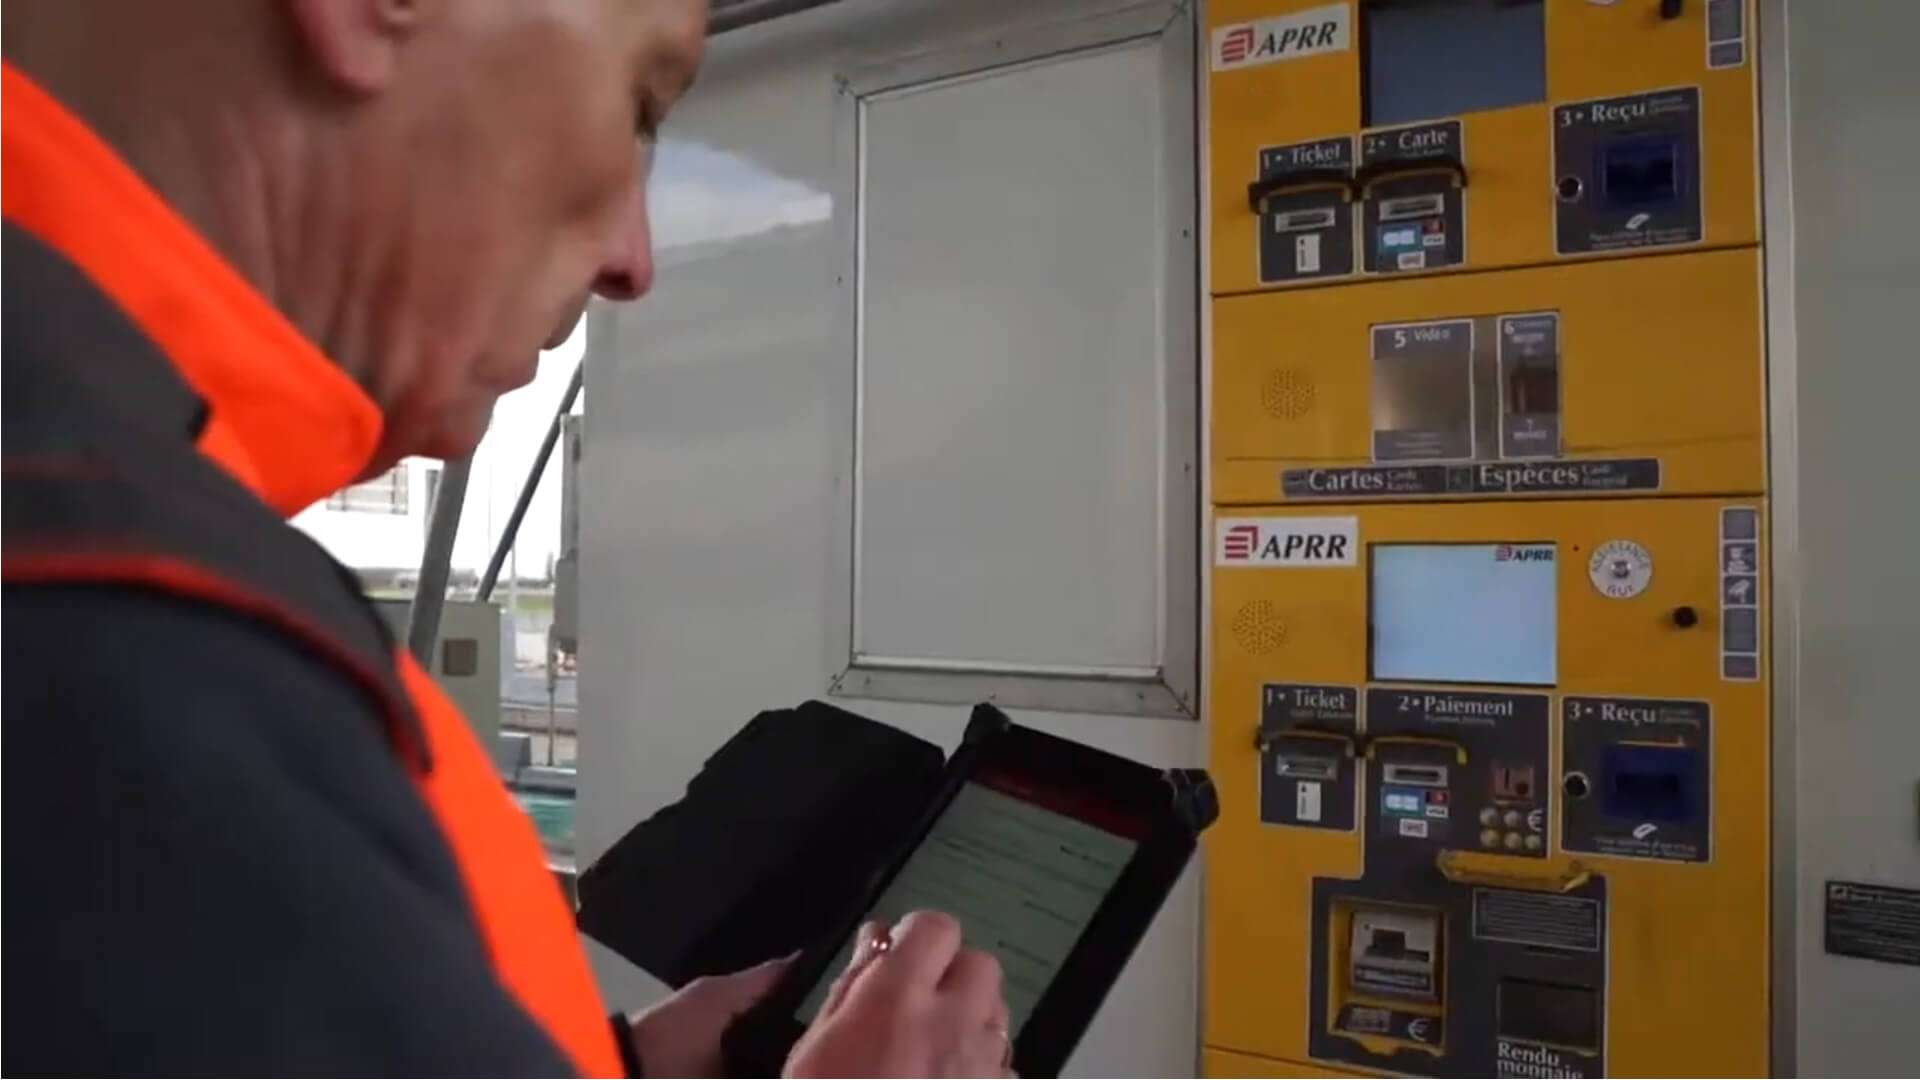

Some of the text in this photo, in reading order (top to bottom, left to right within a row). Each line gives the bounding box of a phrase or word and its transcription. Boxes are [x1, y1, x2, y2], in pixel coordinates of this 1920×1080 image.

[1256, 22, 1337, 57] APRR
[1591, 100, 1646, 124] Reçu
[1398, 128, 1448, 151] Carte
[1290, 142, 1341, 166] Ticket
[1394, 330, 1407, 349] 5
[1309, 468, 1384, 491] Cartes
[1480, 462, 1580, 492] Espèces
[1261, 533, 1348, 560] APRR
[1292, 689, 1346, 710] Ticket
[1424, 695, 1513, 717] Paiement
[1601, 703, 1656, 726] Reçu
[1497, 1041, 1560, 1067] Rendu
